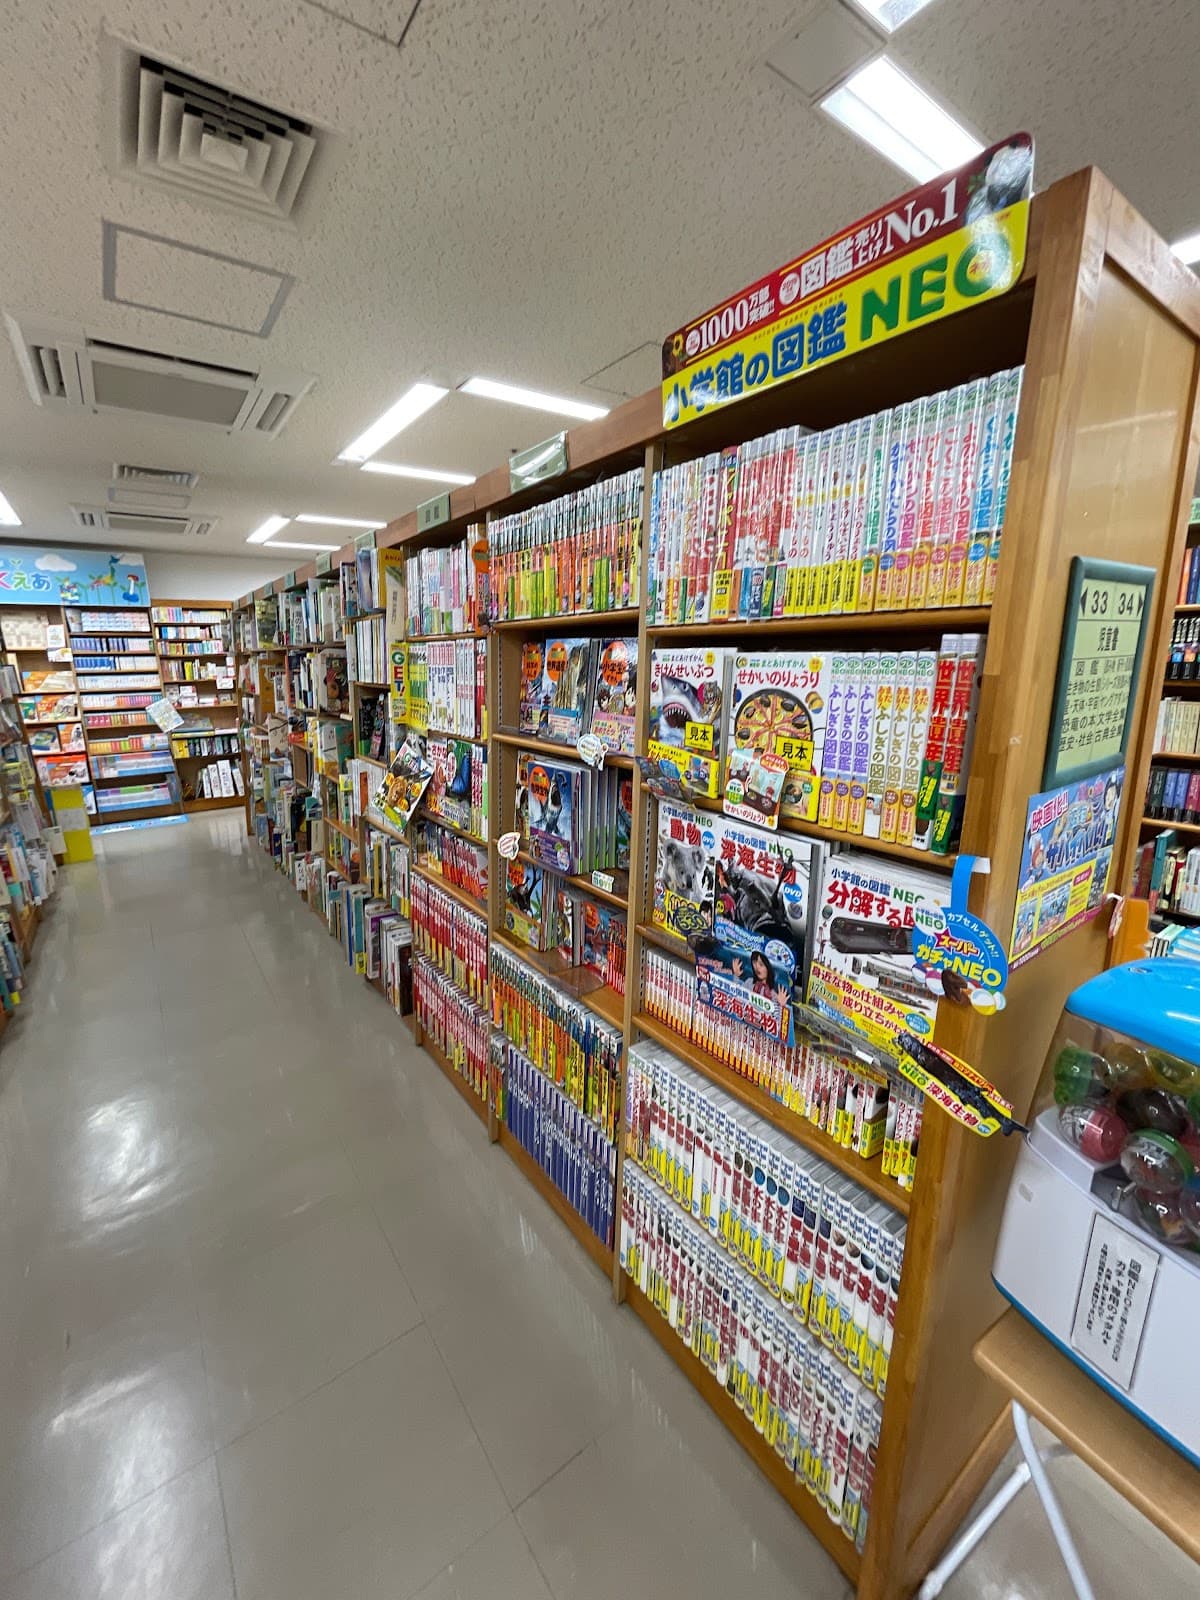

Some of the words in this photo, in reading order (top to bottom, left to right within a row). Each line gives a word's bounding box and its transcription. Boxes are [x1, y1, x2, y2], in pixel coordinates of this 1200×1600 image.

[882, 176, 960, 255] No.1
[801, 236, 853, 299] 図鑑
[664, 301, 848, 423] 小学館の図鑑
[861, 233, 1013, 342] NEO
[700, 298, 749, 354] 1000
[1091, 590, 1109, 615] 33
[1118, 592, 1134, 616] 34
[654, 663, 715, 679] きけんせいぶつ
[738, 668, 820, 688] せかいのりょうり
[823, 684, 842, 769] ふしぎの図鑑
[838, 685, 857, 772] ふしぎの図鑑
[853, 685, 875, 774] ふしぎの図鑑
[925, 660, 957, 761] 世界遺産
[944, 660, 977, 773] 世界遺産
[690, 725, 710, 742] 見本
[782, 741, 808, 762] 見本
[869, 708, 891, 795] ふしぎの図鑑
[662, 805, 694, 823] 小学館の図鑑
[695, 815, 713, 828] NEO
[670, 818, 702, 847] 動物
[720, 837, 797, 886] 深海生物
[724, 828, 767, 851] 小学館の図鑑
[768, 843, 793, 858] NEO
[784, 887, 802, 899] DVD
[831, 868, 891, 896] 小学館の図鑑
[915, 913, 944, 930] NEO
[916, 943, 1002, 987] ガチャNEO
[940, 934, 979, 955] スーパー
[712, 987, 778, 1036] 深海生物
[751, 996, 772, 1011] NEO
[812, 965, 906, 1019] 身近な物の仕組みや
[901, 1063, 927, 1086] NEO
[926, 1080, 979, 1126] 深海生物
